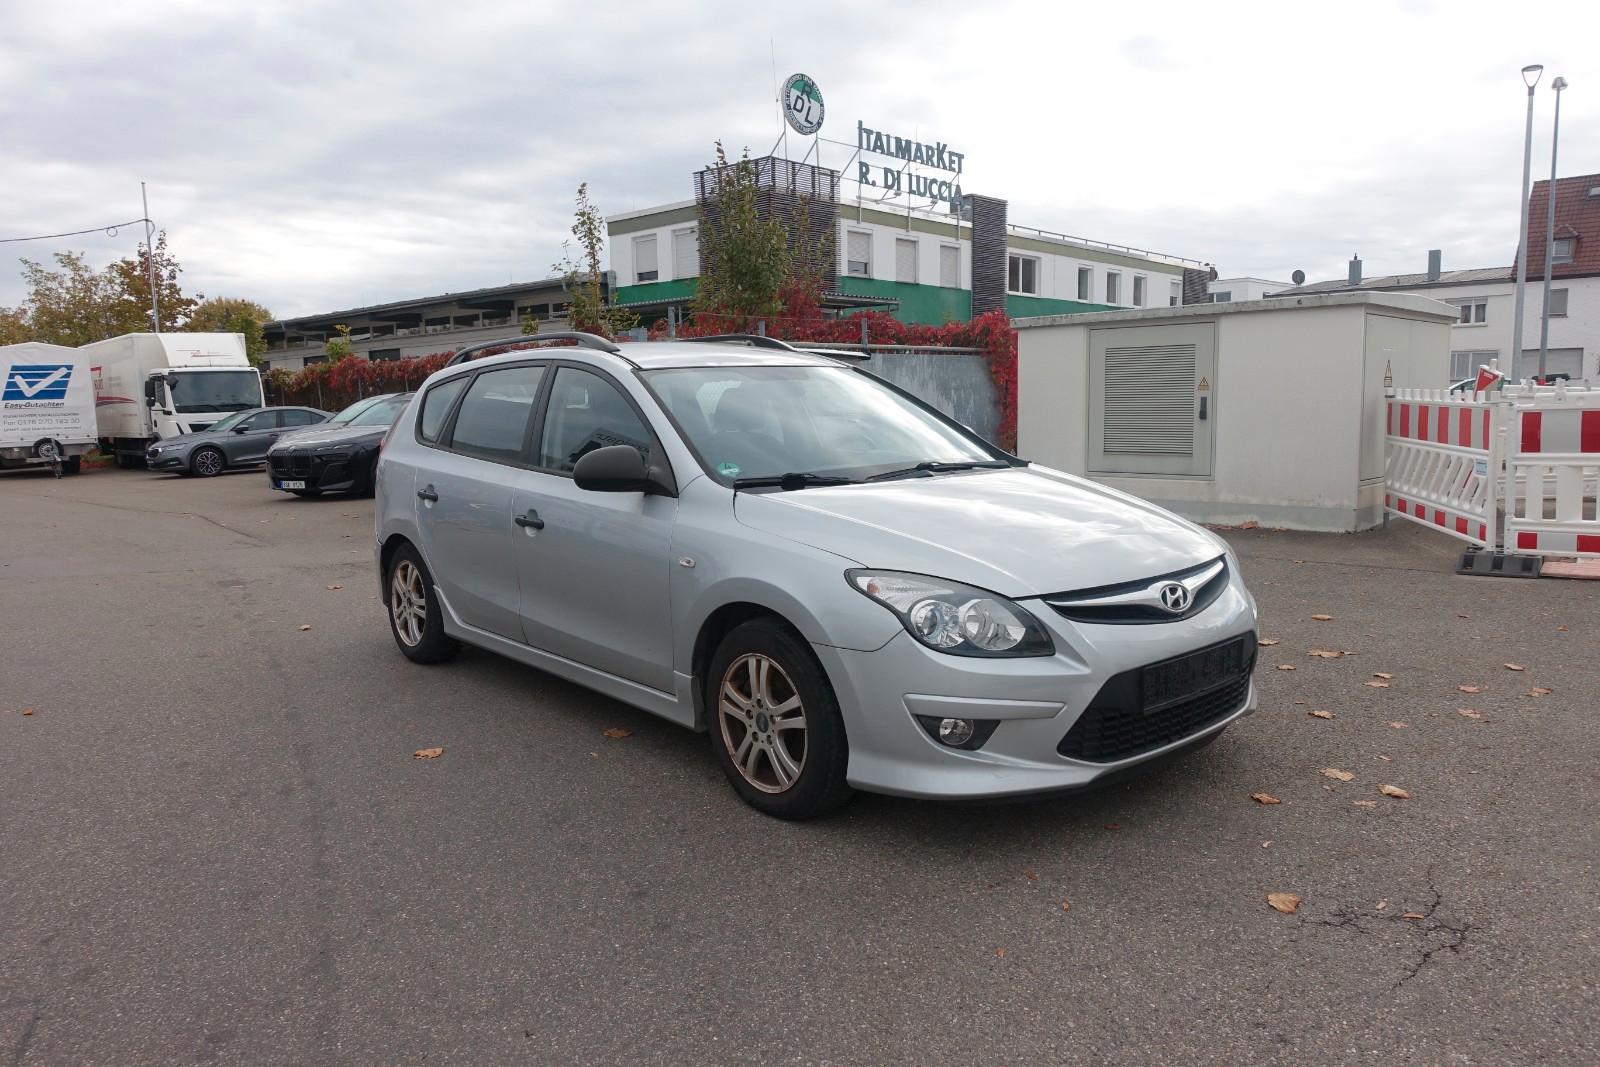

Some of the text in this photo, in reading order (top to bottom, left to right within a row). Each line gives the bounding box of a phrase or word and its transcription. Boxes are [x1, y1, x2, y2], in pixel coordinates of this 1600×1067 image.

[858, 120, 964, 173] ITALMARKET
[859, 161, 963, 203] R. DI LUCCIA
